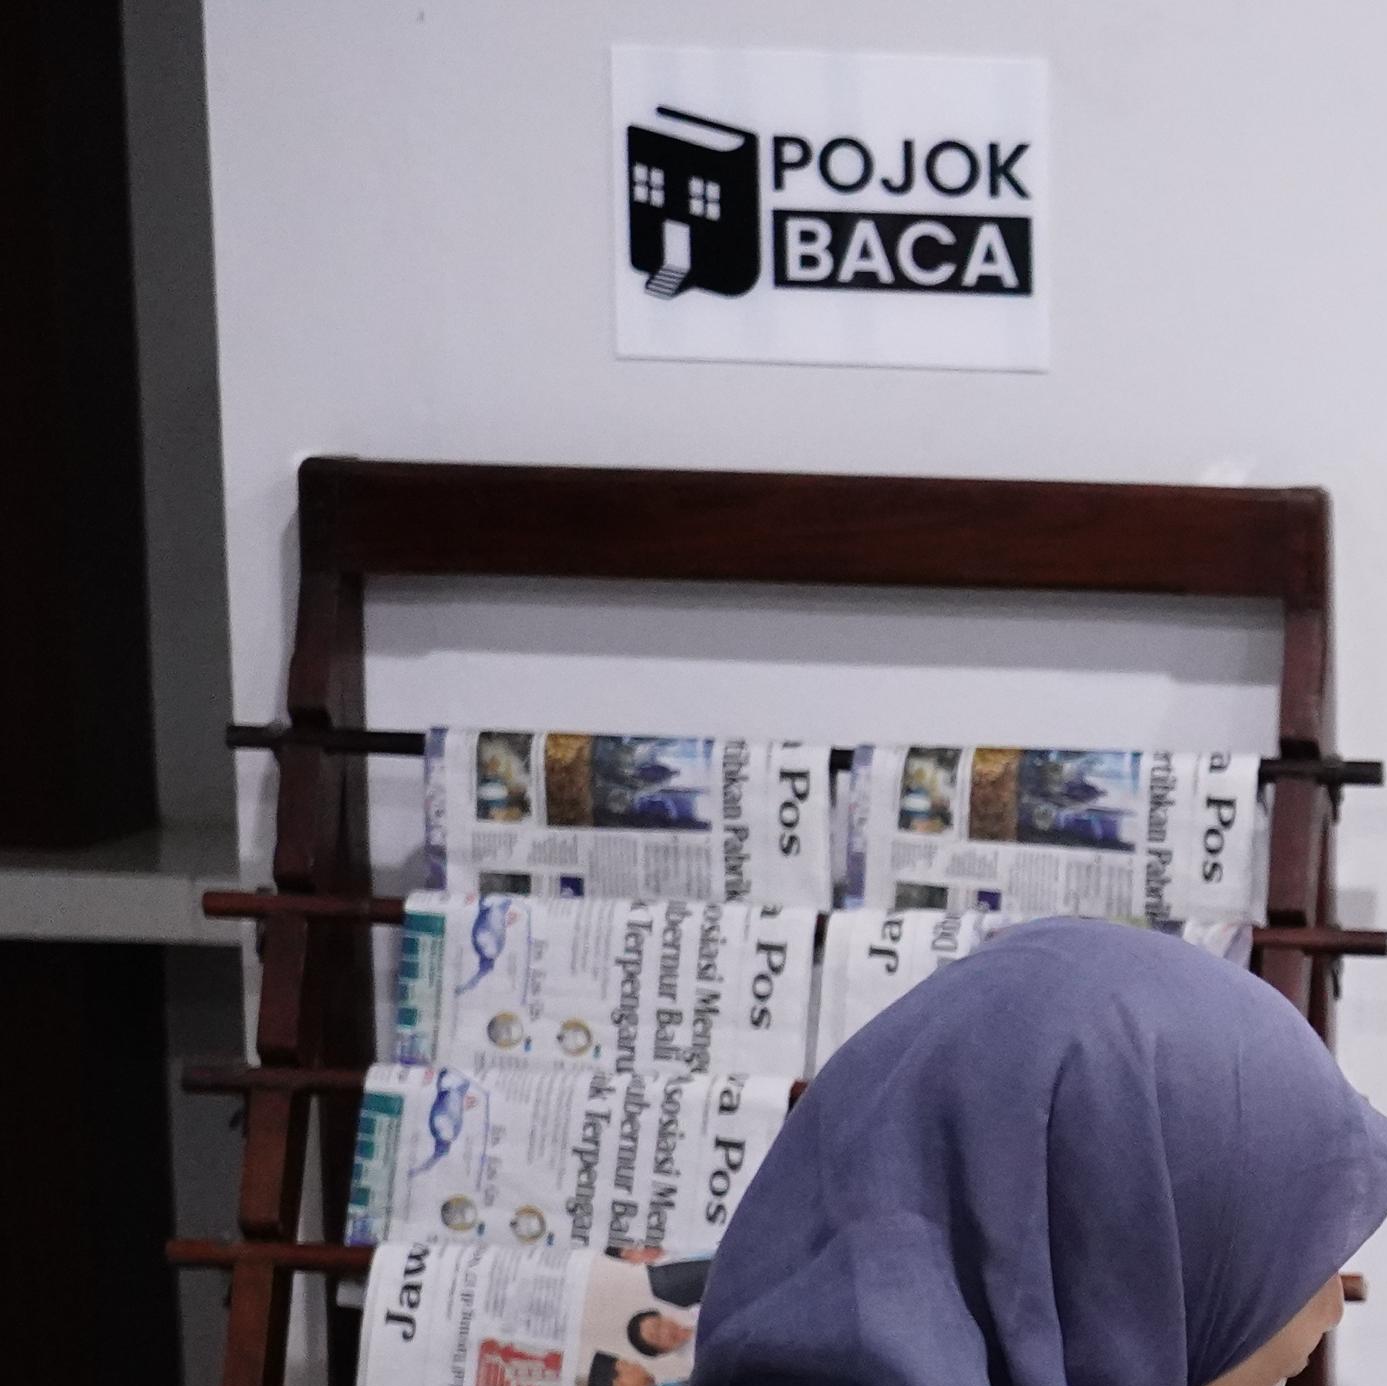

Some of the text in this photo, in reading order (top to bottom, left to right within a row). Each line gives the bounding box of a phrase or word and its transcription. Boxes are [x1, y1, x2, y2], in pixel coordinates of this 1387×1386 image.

[772, 135, 1031, 199] POJOK
[784, 217, 1020, 289] BACA
[778, 767, 811, 858] Pos
[1202, 794, 1238, 884] Pos
[750, 938, 788, 1031] Pos
[868, 912, 904, 976] Ja
[705, 1135, 747, 1226] Pos
